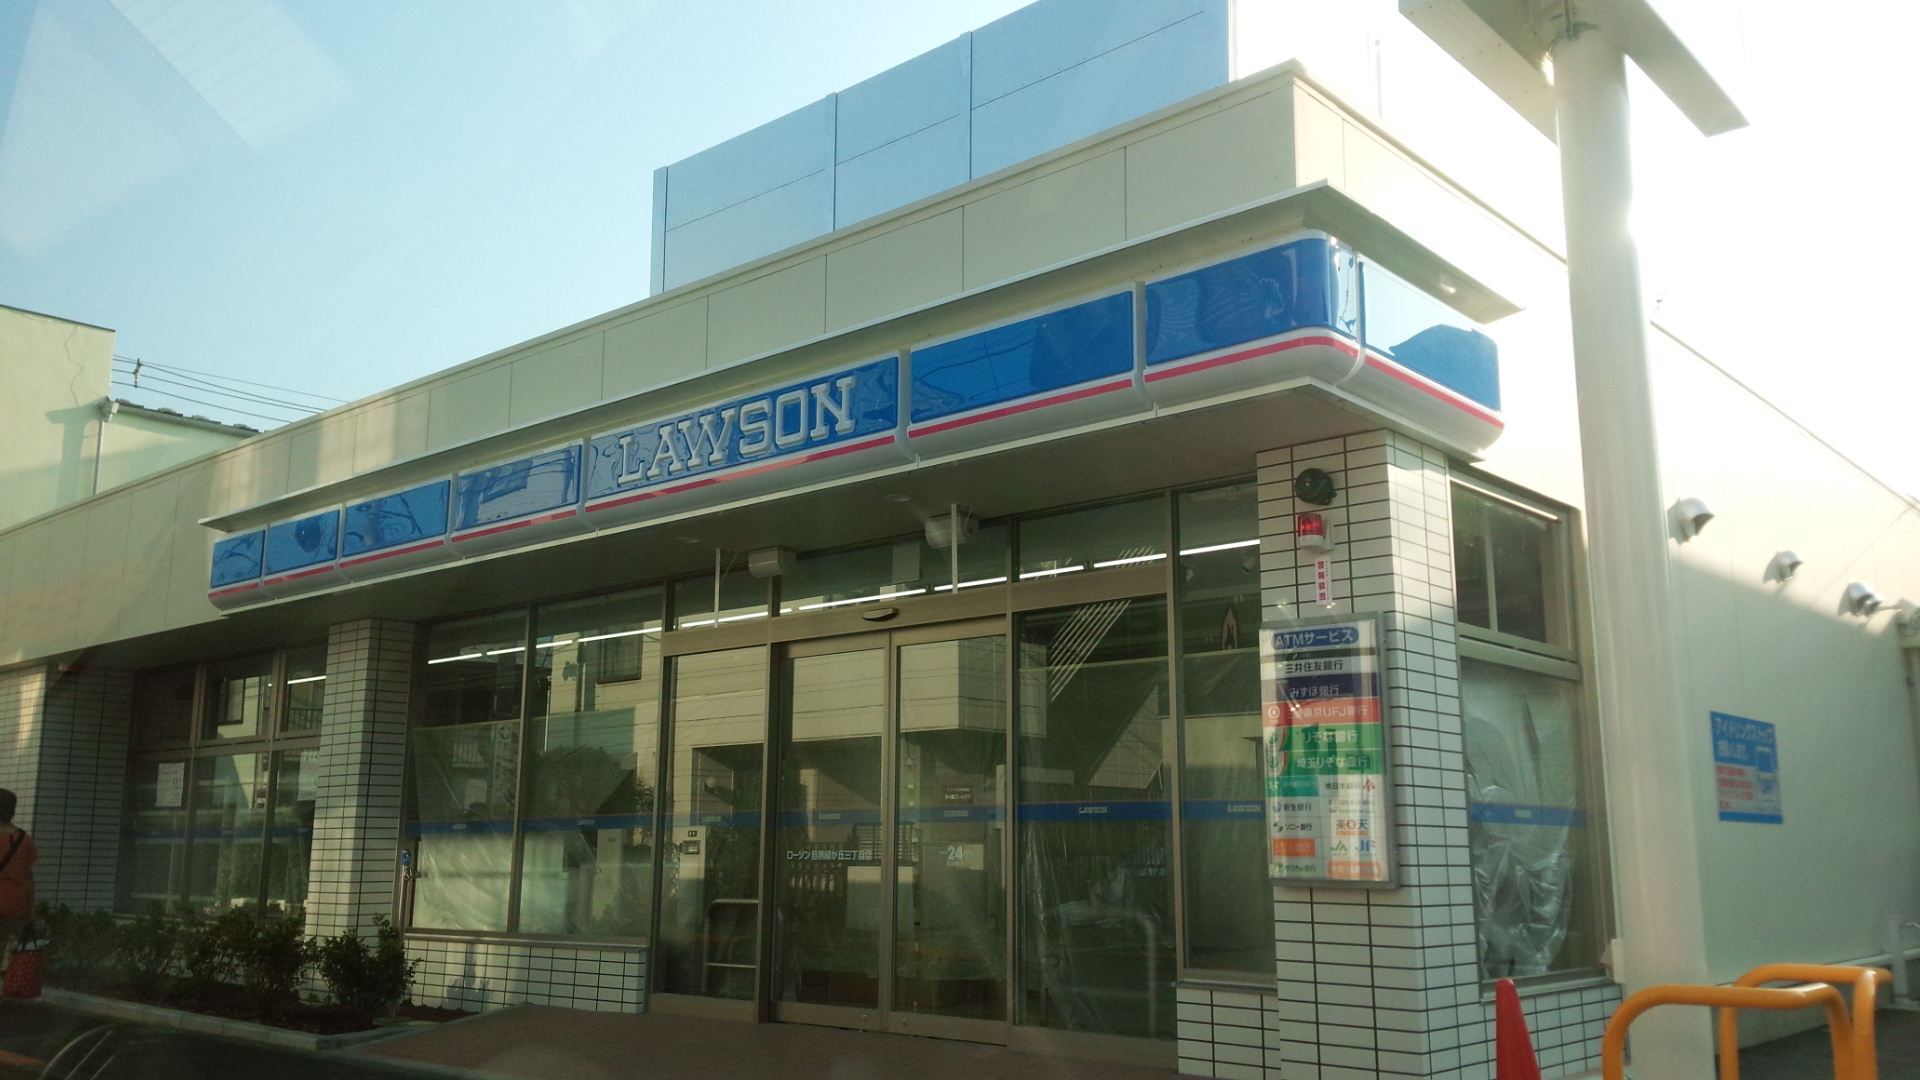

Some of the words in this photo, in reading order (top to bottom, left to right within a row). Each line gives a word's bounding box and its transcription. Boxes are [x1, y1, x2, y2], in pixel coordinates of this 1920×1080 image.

[617, 375, 856, 487] LAWSON
[1275, 629, 1354, 648] ATMサービス
[1285, 659, 1344, 674] 三井住友銀行
[1290, 684, 1340, 698] みずほ銀行
[1297, 755, 1367, 769] 埼玉りそな銀行
[1078, 806, 1108, 814] LAWSON
[1227, 804, 1261, 812] LAWSON
[947, 845, 964, 861] 24
